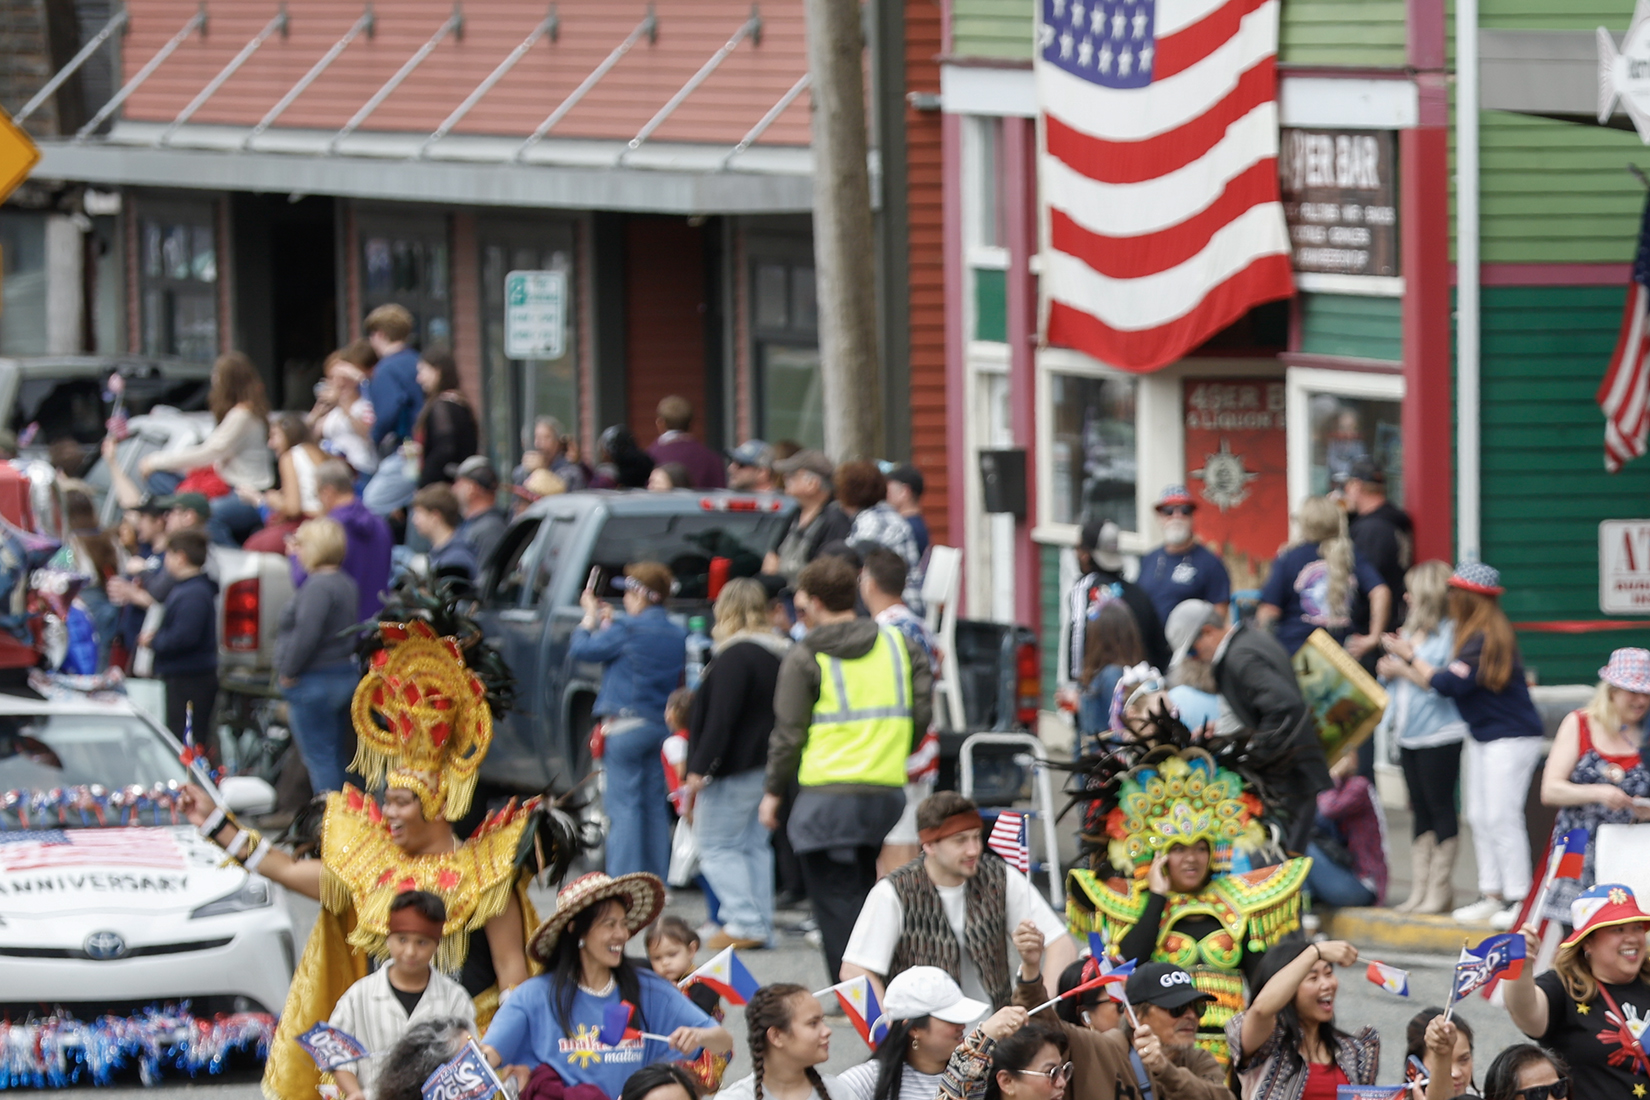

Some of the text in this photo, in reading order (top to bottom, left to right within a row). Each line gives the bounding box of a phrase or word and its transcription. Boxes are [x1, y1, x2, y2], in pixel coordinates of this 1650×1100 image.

[1335, 134, 1380, 189] BAR
[0, 874, 189, 897] ANNIVERSARY
[1160, 970, 1191, 988] GOD
